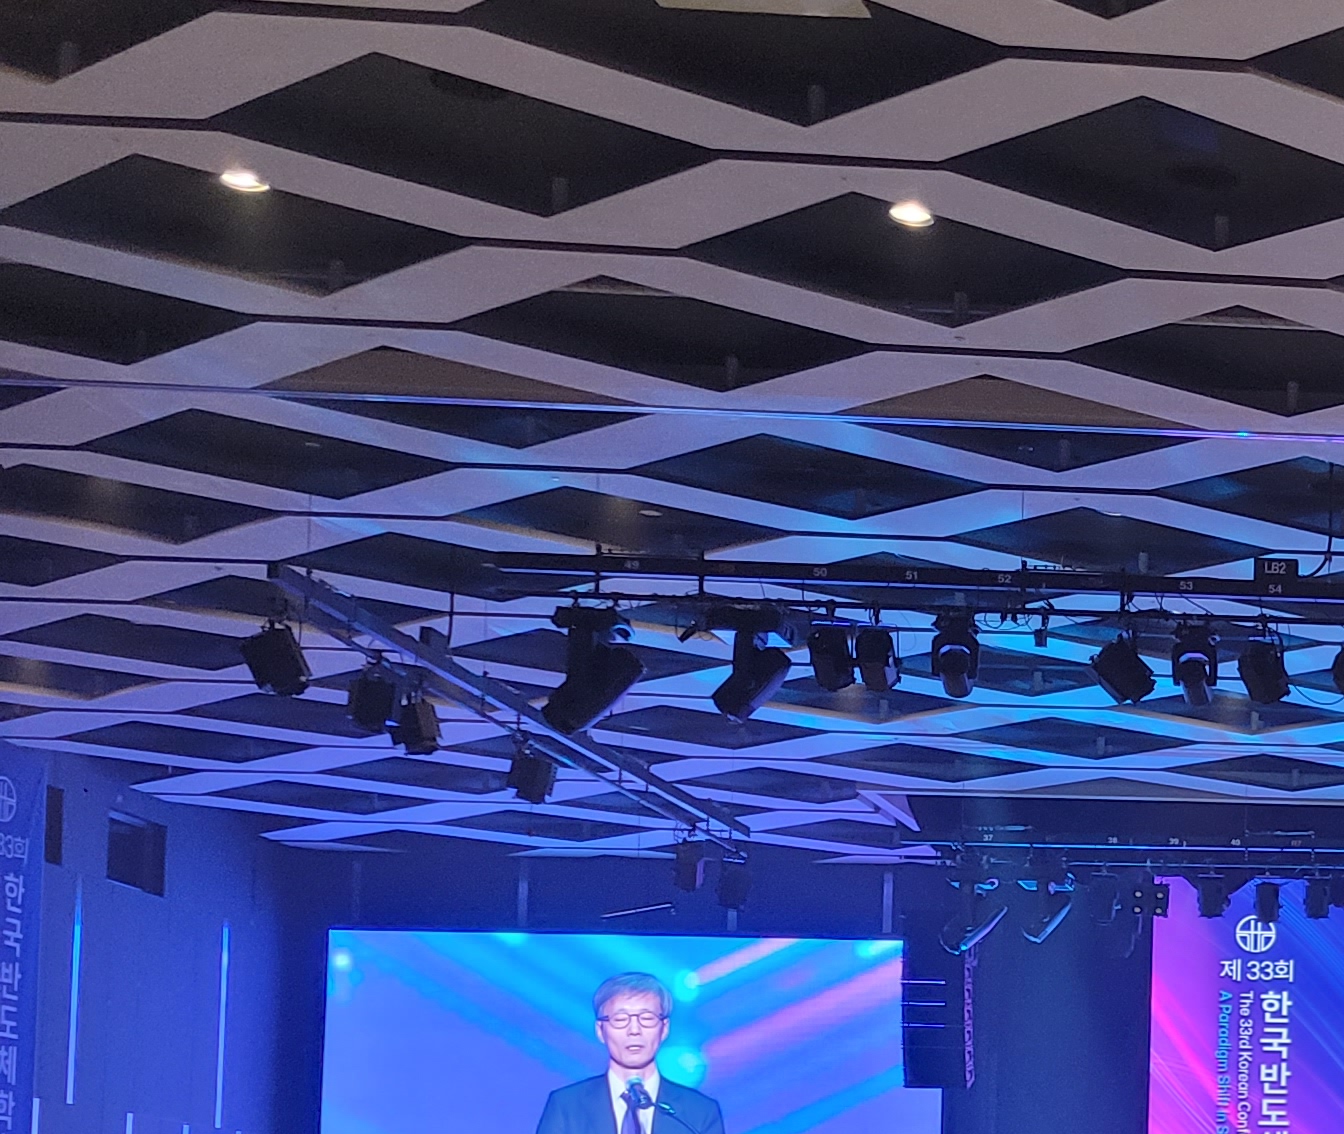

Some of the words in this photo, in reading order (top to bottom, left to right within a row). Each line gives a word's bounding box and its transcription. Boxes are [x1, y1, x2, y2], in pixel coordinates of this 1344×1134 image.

[813, 568, 827, 577] 50
[1264, 562, 1287, 575] LB2
[905, 571, 918, 580] 51
[998, 574, 1012, 583] 52
[1179, 582, 1193, 591] 53
[1269, 585, 1282, 594] 54
[1220, 959, 1241, 982] 제
[1246, 959, 1294, 983] 33회
[1219, 990, 1232, 1001] A
[1239, 991, 1254, 1016] The
[1215, 1005, 1232, 1071] Paradigm
[1239, 1018, 1253, 1048] 33rd
[1237, 1052, 1252, 1098] Korean
